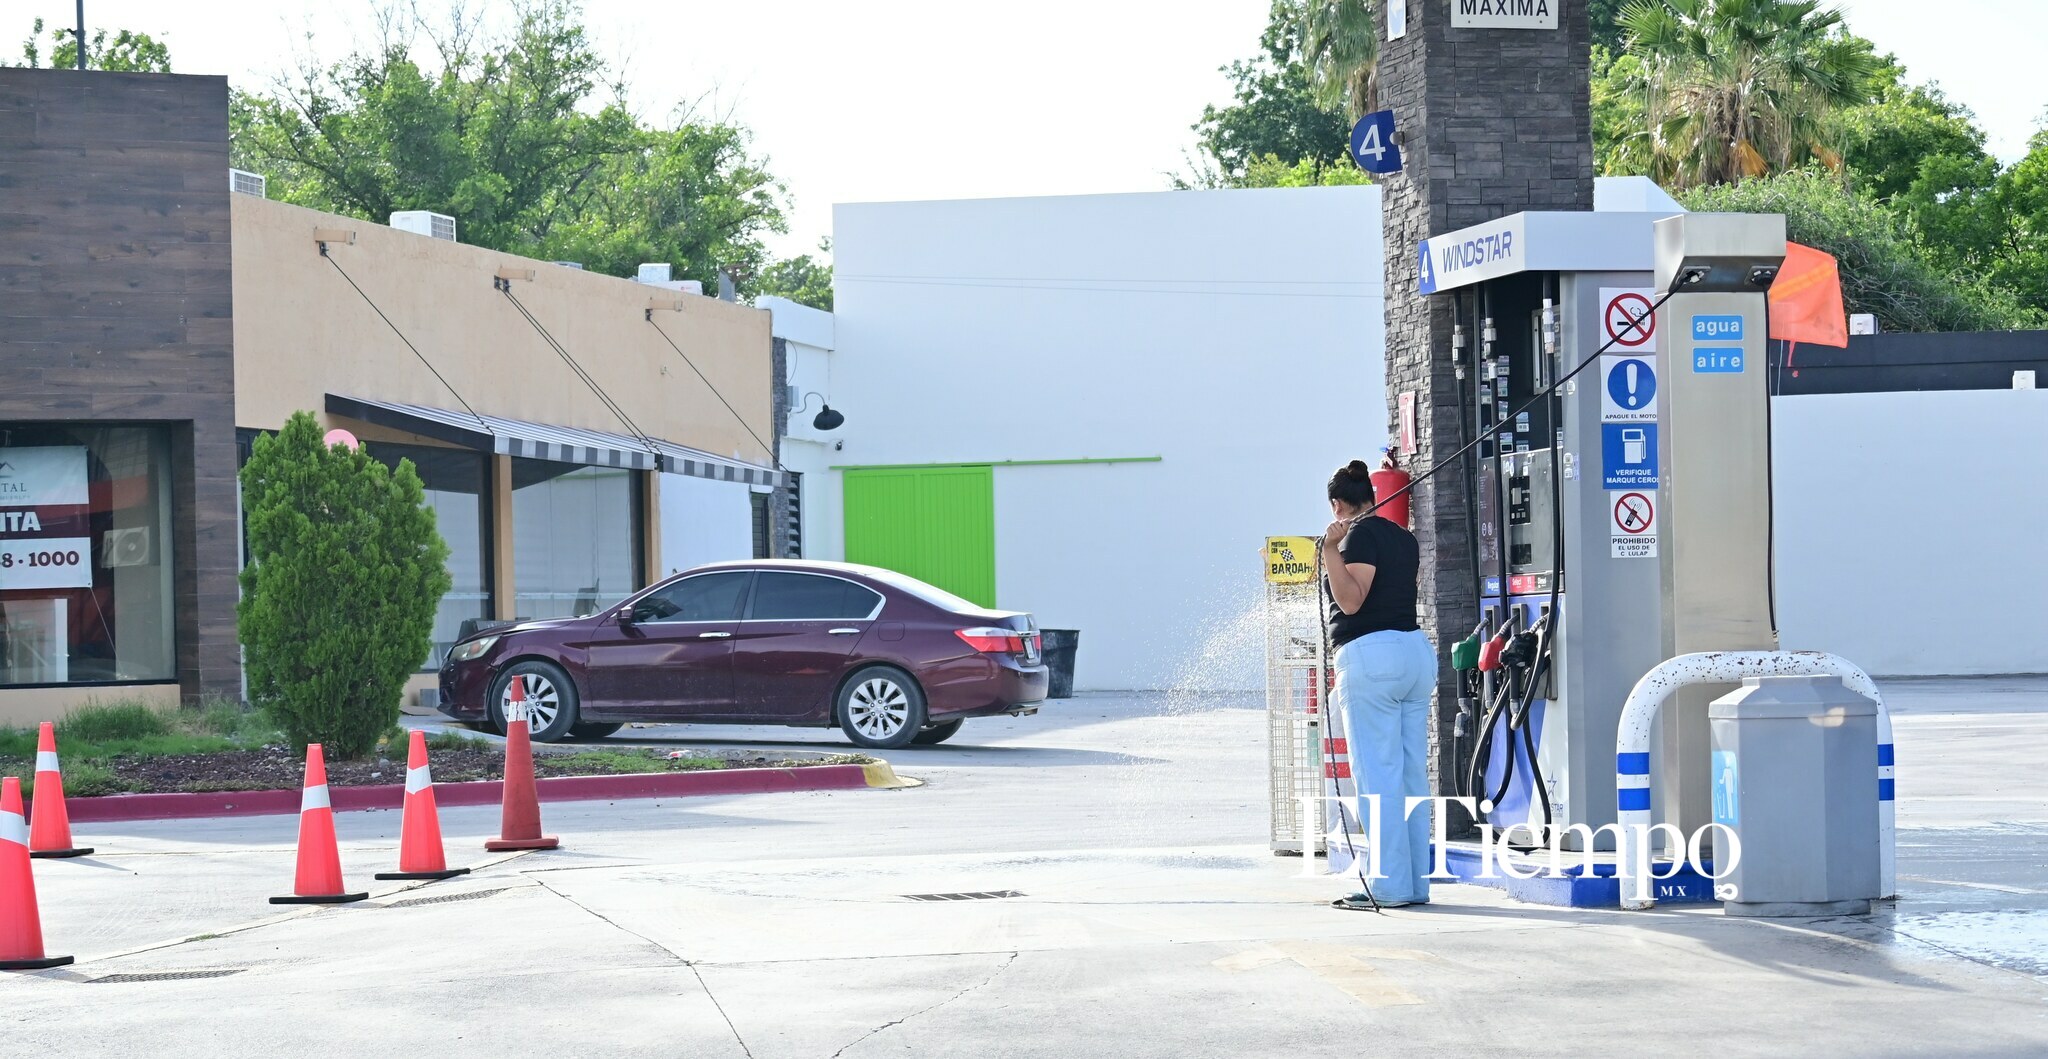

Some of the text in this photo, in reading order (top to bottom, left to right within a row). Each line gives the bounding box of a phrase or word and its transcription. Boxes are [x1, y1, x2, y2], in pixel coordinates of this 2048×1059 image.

[1460, 0, 1549, 16] MAXIMA
[1359, 124, 1386, 161] 4
[1421, 230, 1512, 284] 4 WINDSTAR
[1696, 321, 1740, 336] agua
[1697, 353, 1741, 368] aire
[28, 550, 80, 567] 1000
